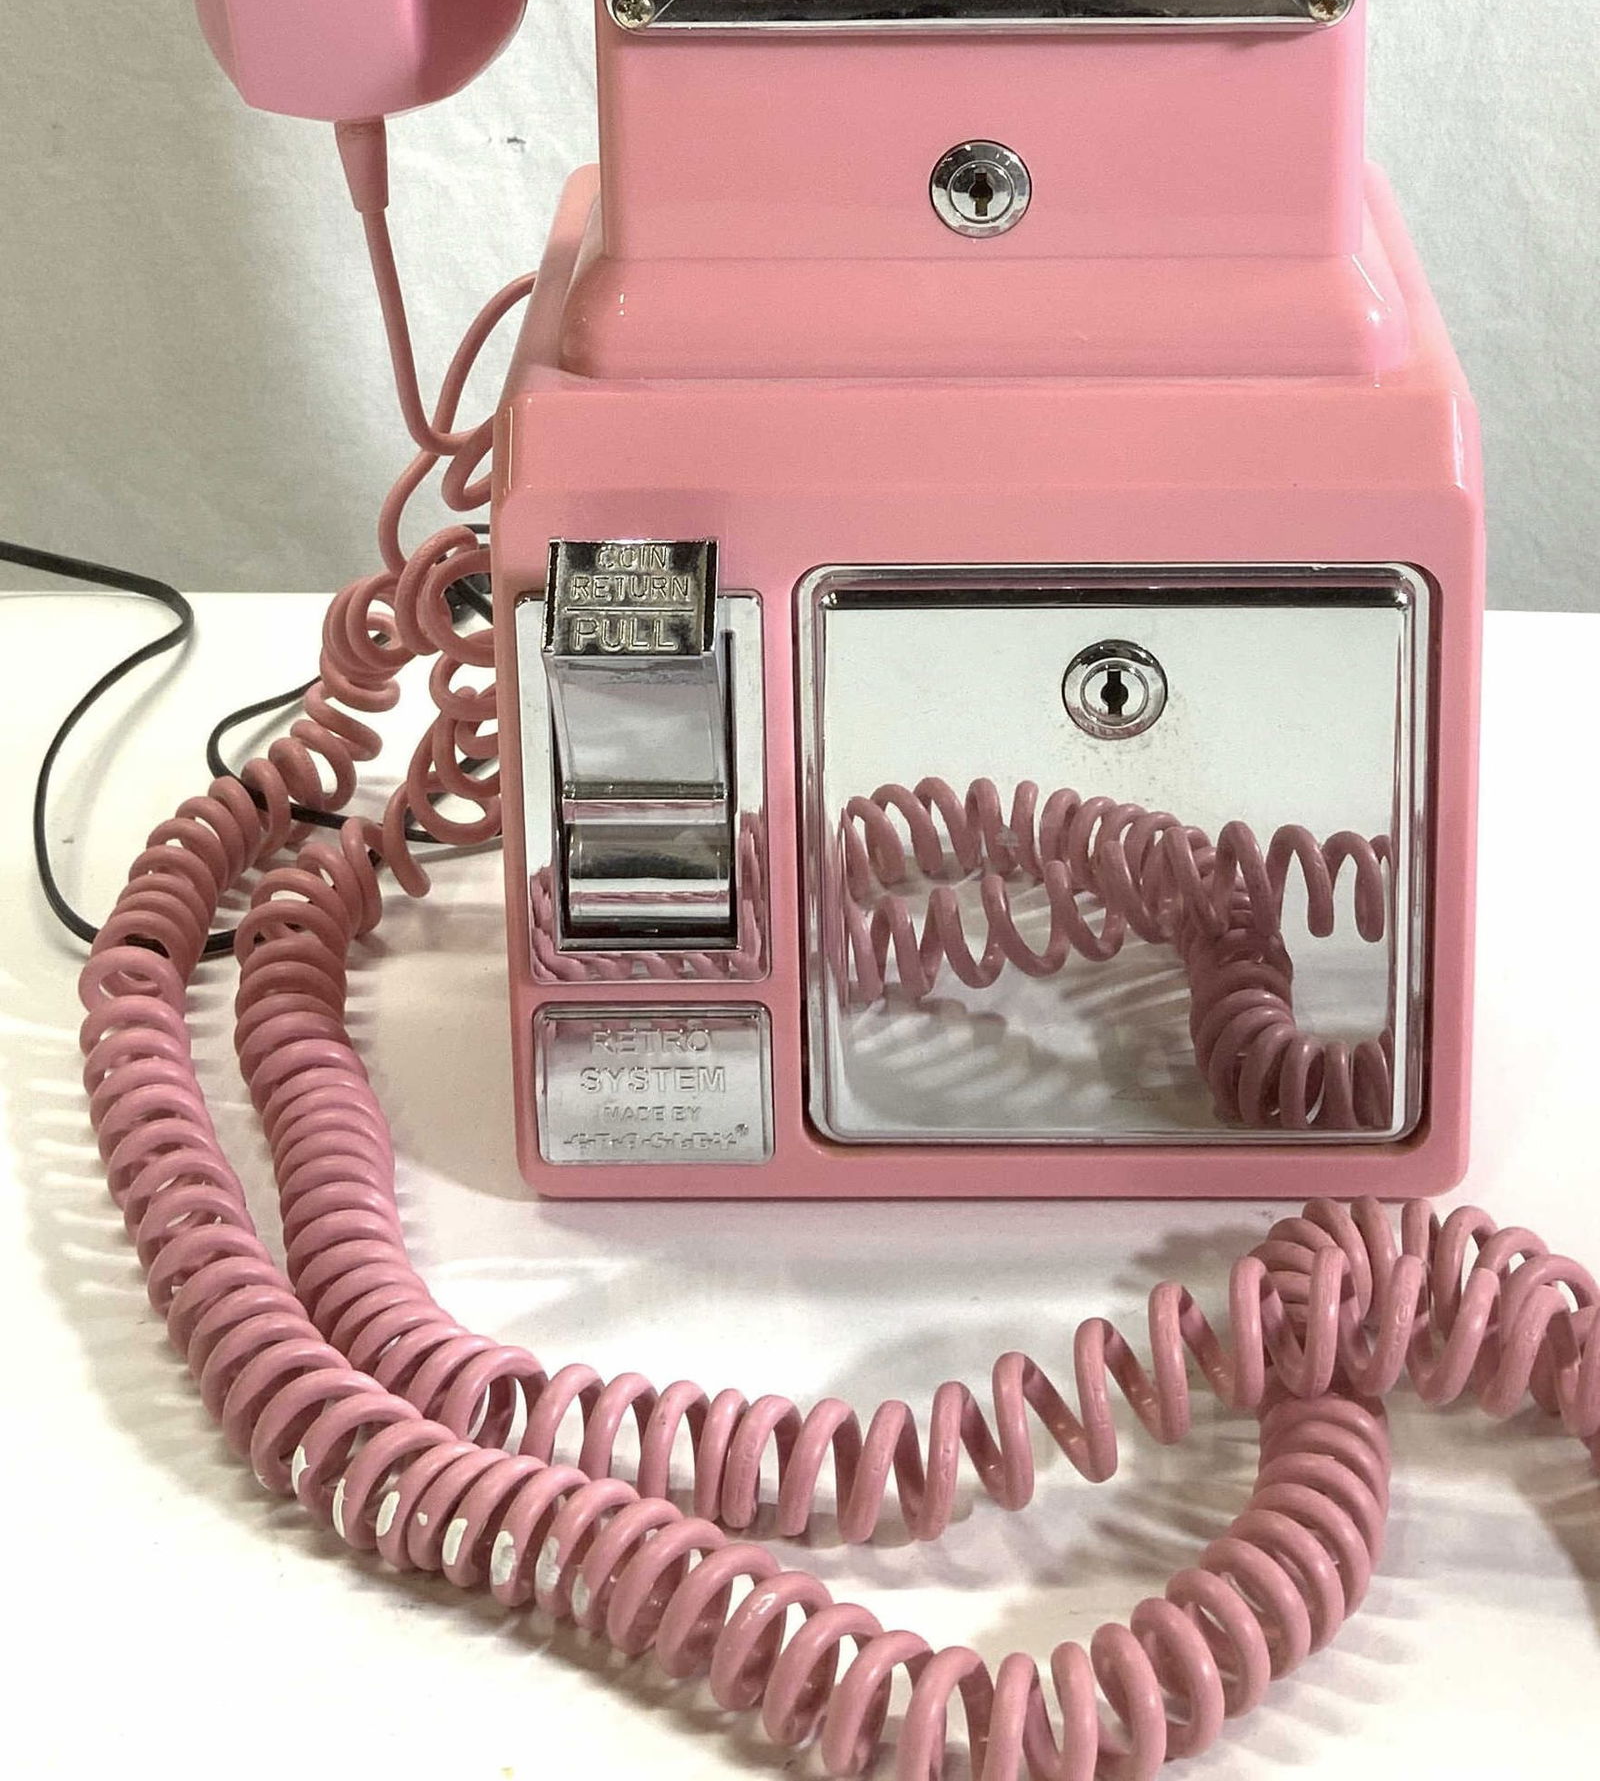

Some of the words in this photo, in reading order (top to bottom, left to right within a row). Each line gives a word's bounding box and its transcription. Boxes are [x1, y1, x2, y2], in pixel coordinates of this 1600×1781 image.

[597, 545, 668, 570] COIN
[571, 574, 692, 603] RETURN
[570, 616, 679, 653] PULL
[590, 1028, 712, 1054] RETRO
[578, 1066, 727, 1092] SYSTEM
[604, 1106, 665, 1121] MADE
[671, 1106, 702, 1121] BY
